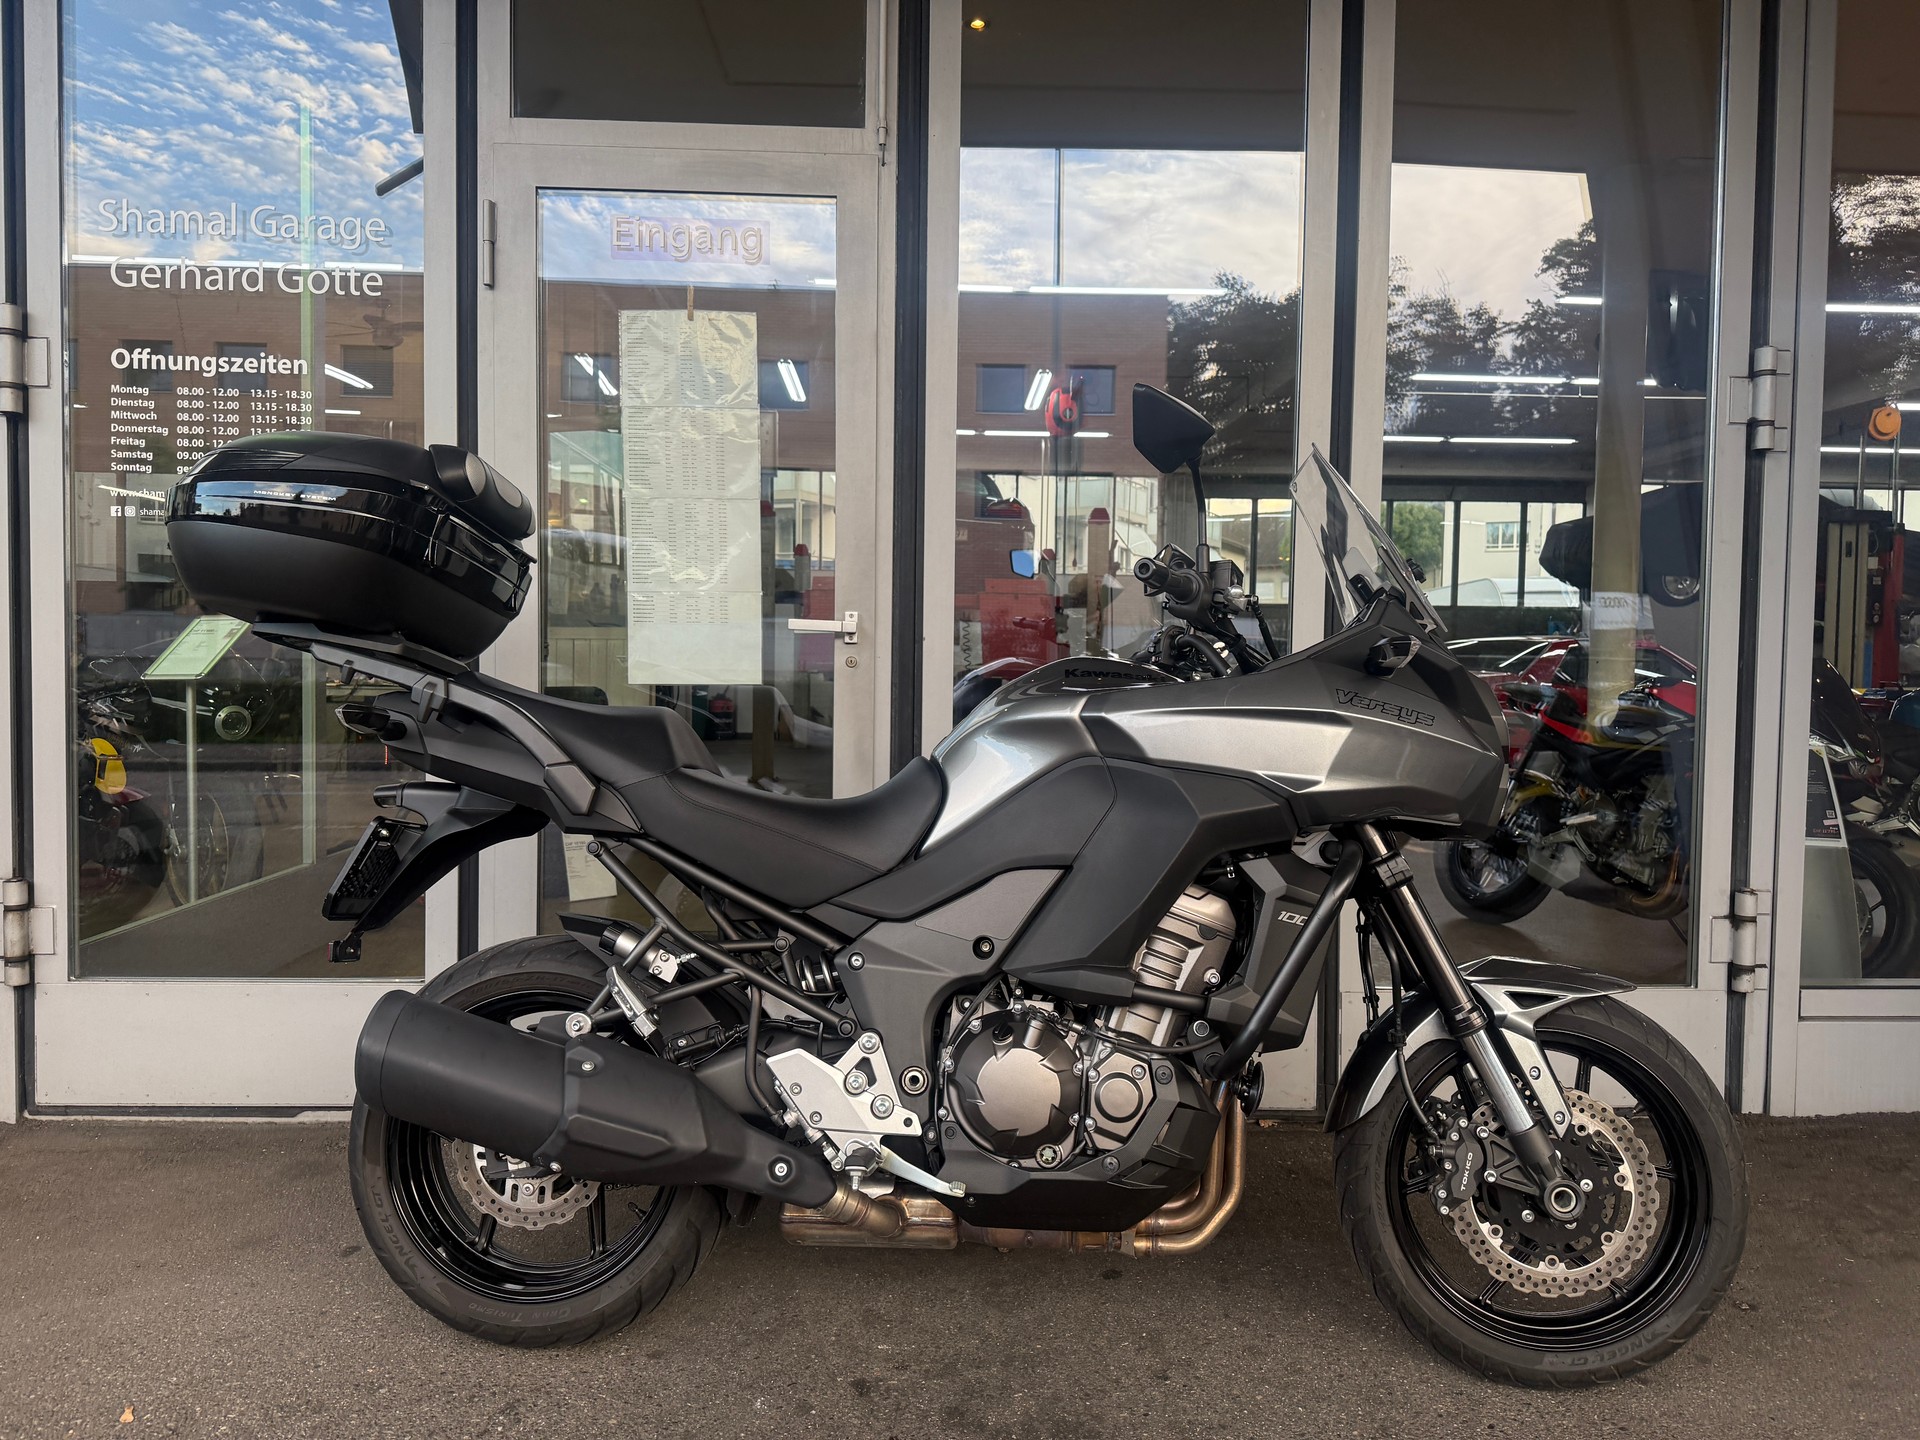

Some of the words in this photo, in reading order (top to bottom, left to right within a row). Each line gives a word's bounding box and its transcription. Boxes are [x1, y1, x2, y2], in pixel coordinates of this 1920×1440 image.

[98, 199, 237, 237] Shamal
[250, 205, 386, 250] Garage
[612, 215, 761, 263] Eingang
[110, 256, 264, 292] Gerhard
[277, 263, 383, 296] Gotte
[110, 385, 149, 396] Montag
[177, 387, 204, 396] 08.00
[212, 388, 239, 397] 12.00
[250, 389, 277, 398] 13.15
[285, 390, 312, 399] 18.30
[110, 398, 155, 409] Dienstag
[177, 400, 204, 409] 08.00
[212, 401, 239, 410] 12.00
[250, 402, 277, 411] 13.15
[285, 403, 312, 412] 18.30
[110, 411, 157, 421] Mittwoch
[177, 413, 204, 422] 08.00
[212, 414, 239, 423] 12.00
[250, 415, 277, 424] 13.15
[285, 416, 312, 425] 18.30
[110, 424, 169, 436] Donnerstag
[177, 426, 204, 435] 08.00
[212, 427, 239, 436] 12.00
[110, 437, 146, 448] Freitag
[177, 439, 204, 448] 08.00
[110, 449, 153, 460] Samstag
[110, 462, 152, 473] Sonntag
[1335, 688, 1436, 727] Versys
[1460, 1152, 1473, 1191] TOKICO
